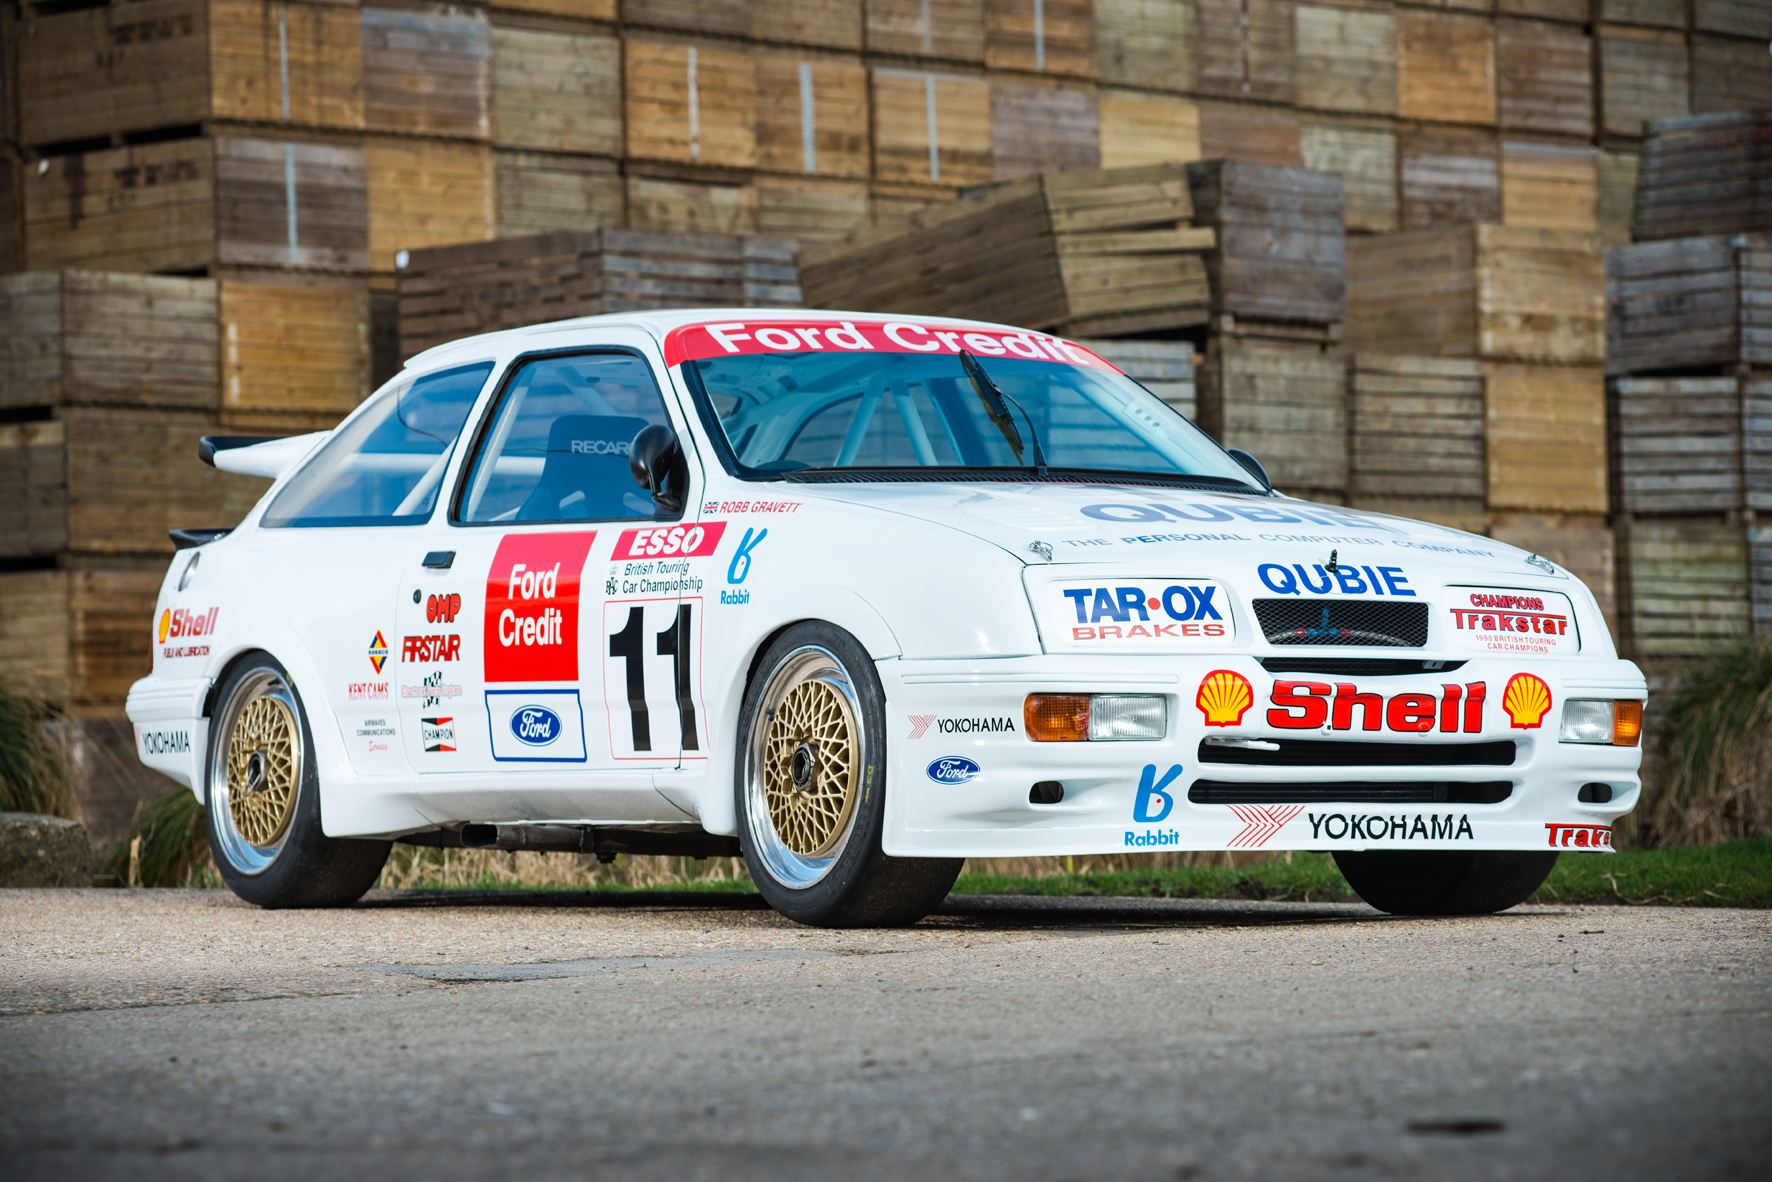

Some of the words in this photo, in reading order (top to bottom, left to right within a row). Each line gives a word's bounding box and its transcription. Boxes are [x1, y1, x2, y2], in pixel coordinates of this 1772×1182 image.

[704, 321, 874, 353] Ford
[883, 322, 1090, 366] Credit
[571, 440, 631, 454] RECAR
[719, 501, 750, 514] ROBB
[750, 501, 803, 513] GRAVETT
[1080, 503, 1385, 530] QUBIE
[628, 527, 704, 556] ESSO
[1061, 538, 1113, 548] THE
[1121, 532, 1252, 544] PERSONAL
[1257, 533, 1384, 546] COMPUTER
[1390, 539, 1497, 559] COMPANY
[624, 562, 653, 576] British
[656, 561, 690, 576] Touring
[508, 562, 560, 600] Ford
[622, 580, 638, 594] Car
[640, 576, 703, 595] Championship
[1257, 563, 1416, 597] QUBIE
[426, 594, 461, 623] OMP
[721, 590, 749, 605] Rabbit
[1470, 593, 1544, 611] CHAMPIONS
[170, 606, 219, 637] Shell
[499, 608, 562, 647] Credit
[1072, 623, 1225, 640] BRAKES
[1450, 609, 1567, 635] Trakstar
[401, 634, 460, 662] FIRSTAIR
[1494, 635, 1523, 644] BRITISH
[1524, 637, 1556, 646] TOURING
[1504, 643, 1548, 653] CHAMPIONS
[610, 604, 699, 751] 11
[349, 683, 366, 700] KENT
[368, 682, 389, 700] CAMS
[1267, 680, 1485, 733] Shell
[357, 728, 395, 737] COMMUNICATIONS
[364, 719, 386, 727] AIRWAVES
[520, 709, 551, 738] Ford
[937, 716, 1015, 733] YOKOHAMA
[142, 730, 191, 755] YOKOHAMA
[424, 729, 453, 741] CHAMPION
[937, 760, 969, 779] Ford
[1308, 813, 1474, 840] YOKOHAMA
[1124, 829, 1179, 847] Rabbit
